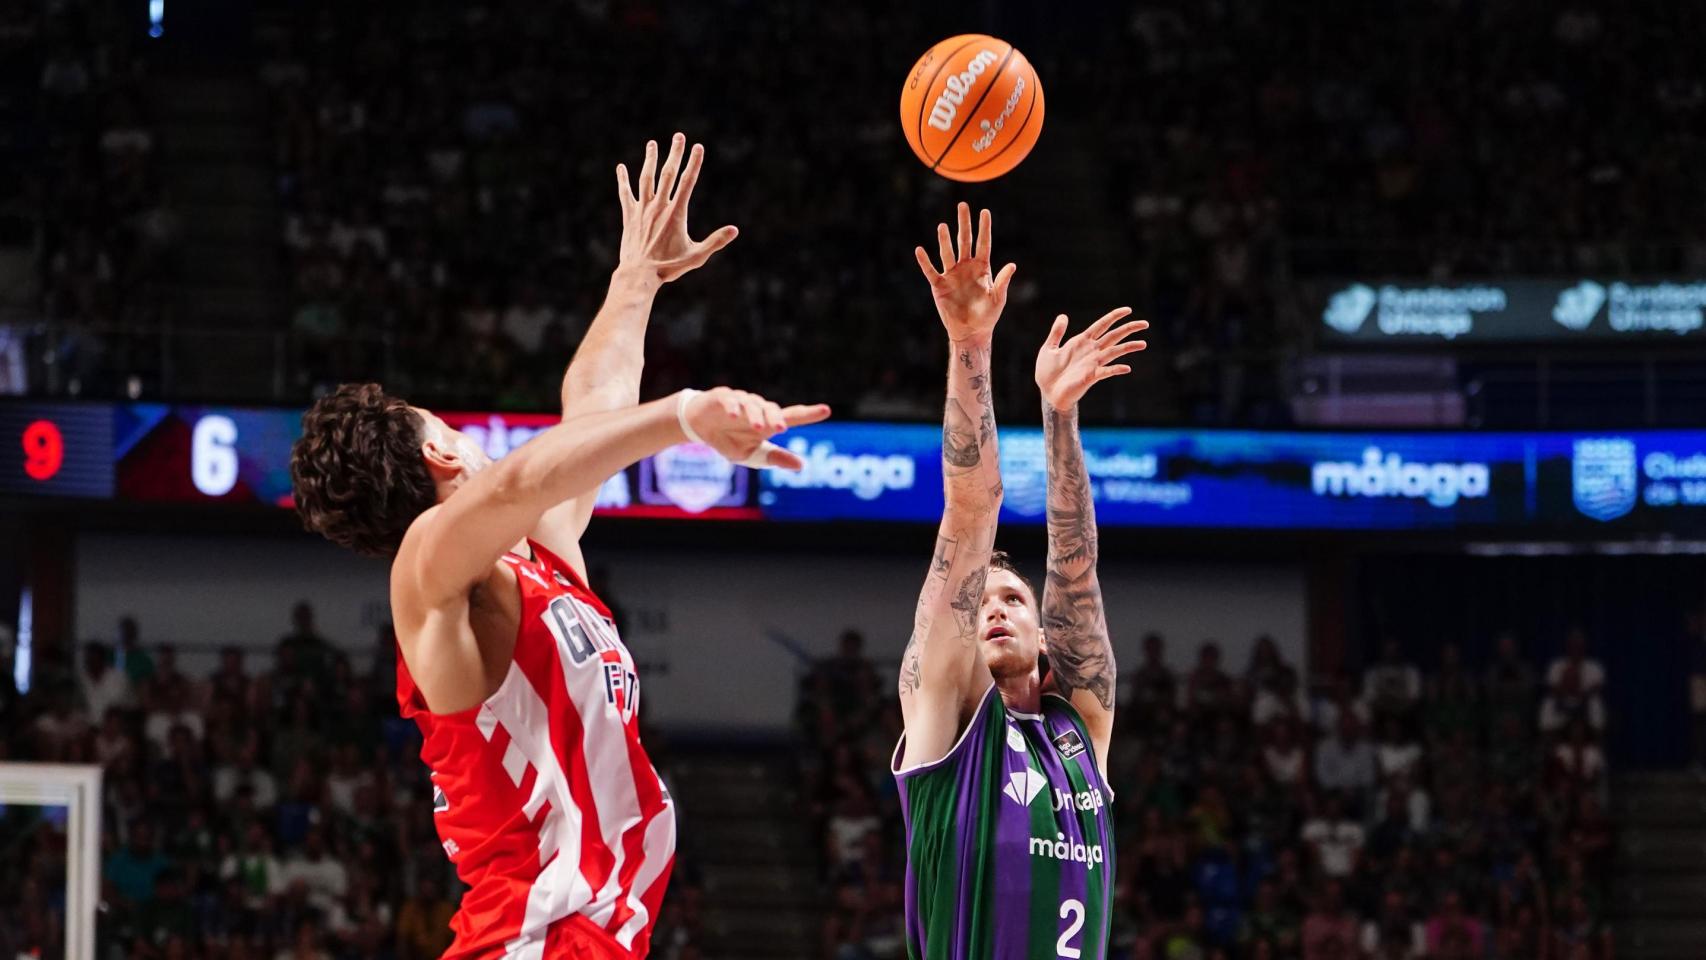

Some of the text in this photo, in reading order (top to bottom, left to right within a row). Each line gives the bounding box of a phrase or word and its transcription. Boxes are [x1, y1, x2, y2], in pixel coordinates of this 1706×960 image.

[928, 50, 998, 132] Wilson
[21, 418, 64, 481] 9
[191, 414, 239, 497] 6
[1056, 899, 1086, 960] 2
